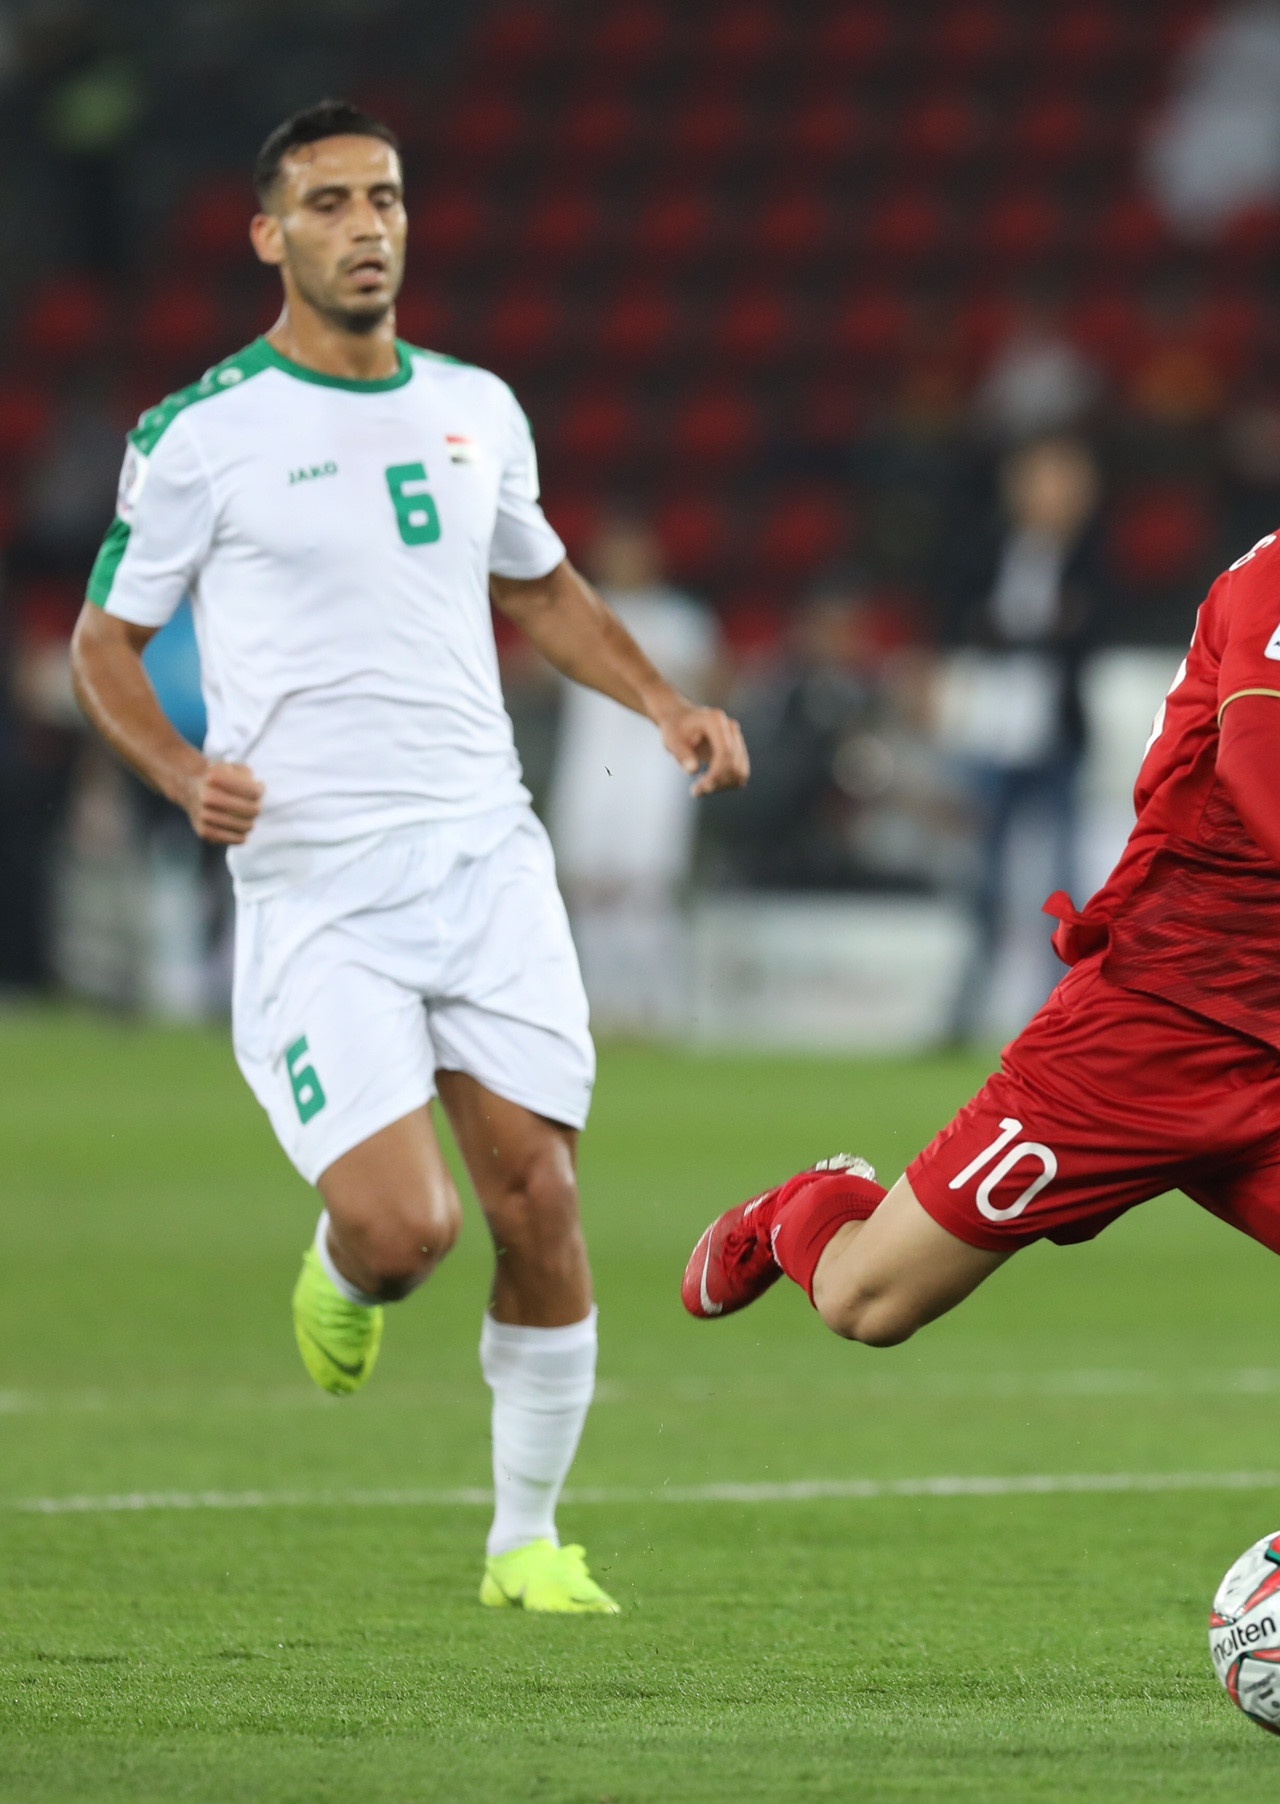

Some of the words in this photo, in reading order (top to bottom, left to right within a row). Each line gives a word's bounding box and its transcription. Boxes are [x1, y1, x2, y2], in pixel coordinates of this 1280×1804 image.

[287, 461, 339, 486] JAKO
[385, 462, 442, 547] 6
[286, 1035, 327, 1125] 6
[948, 1117, 1058, 1222] 10
